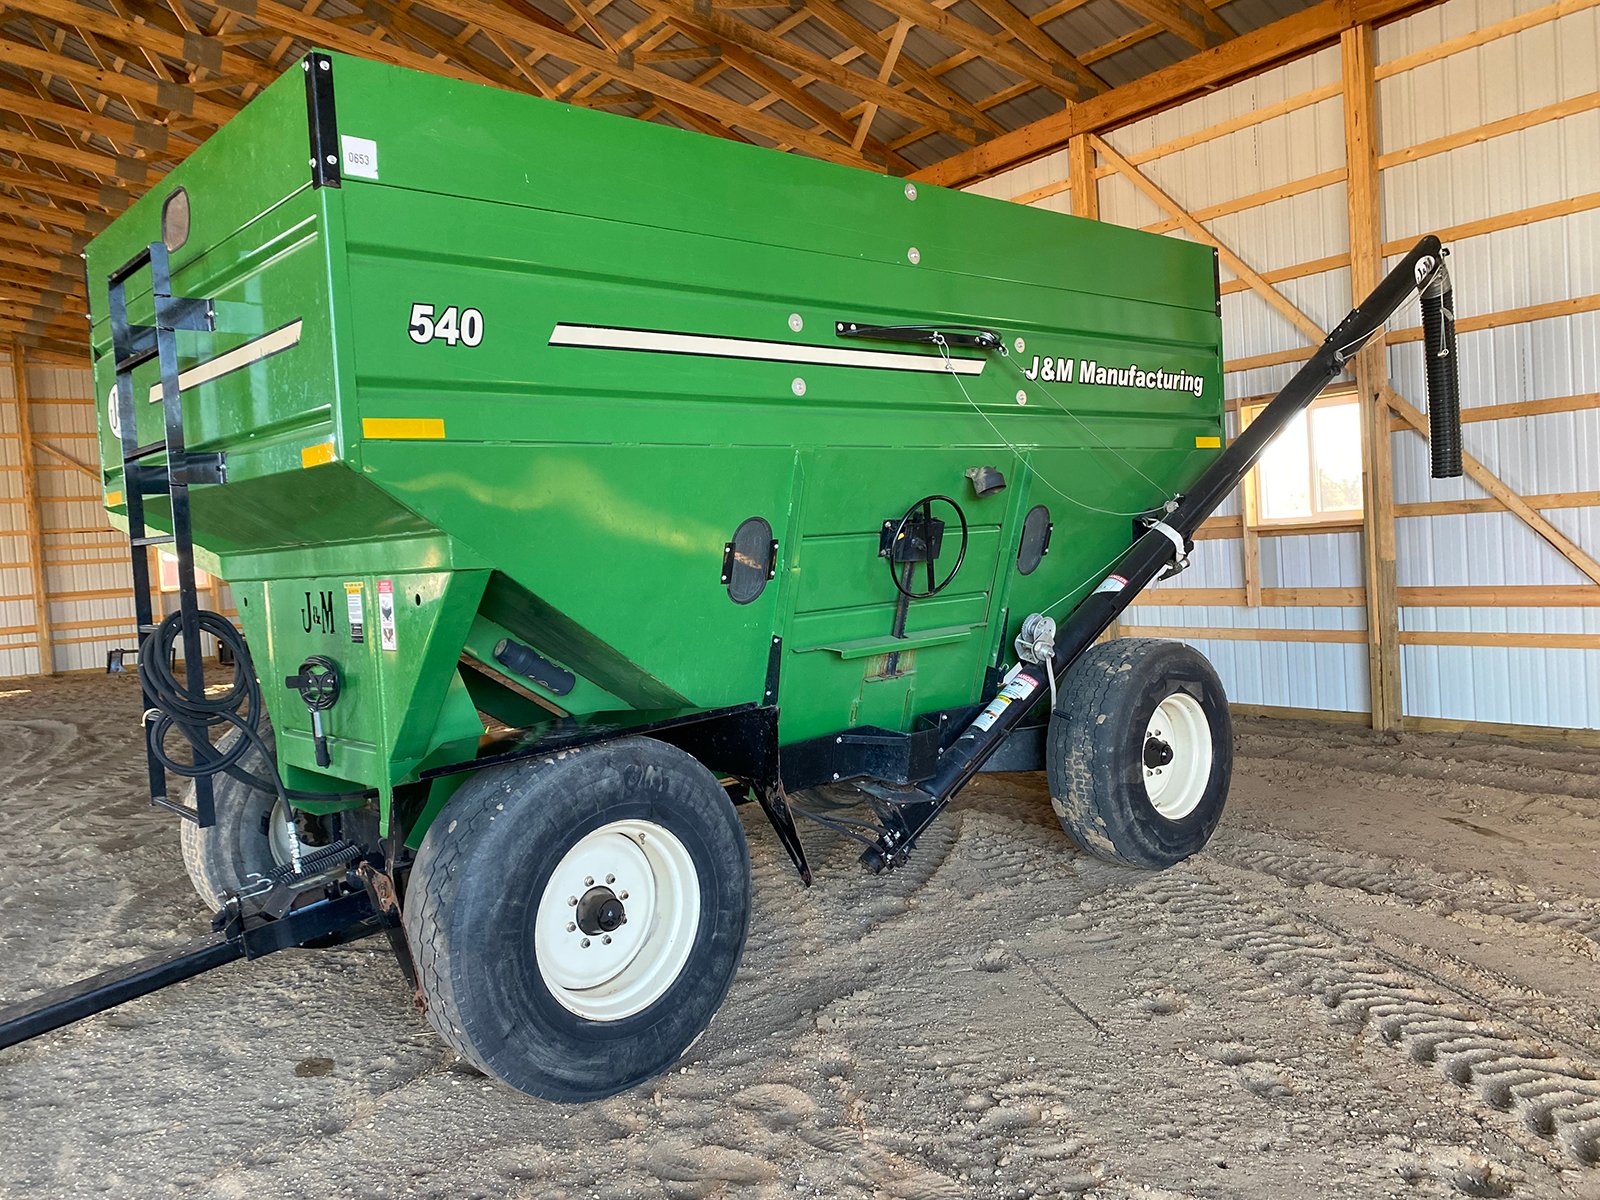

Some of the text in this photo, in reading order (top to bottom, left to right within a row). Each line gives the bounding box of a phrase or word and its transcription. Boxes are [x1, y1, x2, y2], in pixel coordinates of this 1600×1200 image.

[348, 151, 370, 166] 0653
[408, 302, 485, 348] 540
[1024, 355, 1205, 398] J&M Manufacturing
[301, 591, 336, 634] J&M
